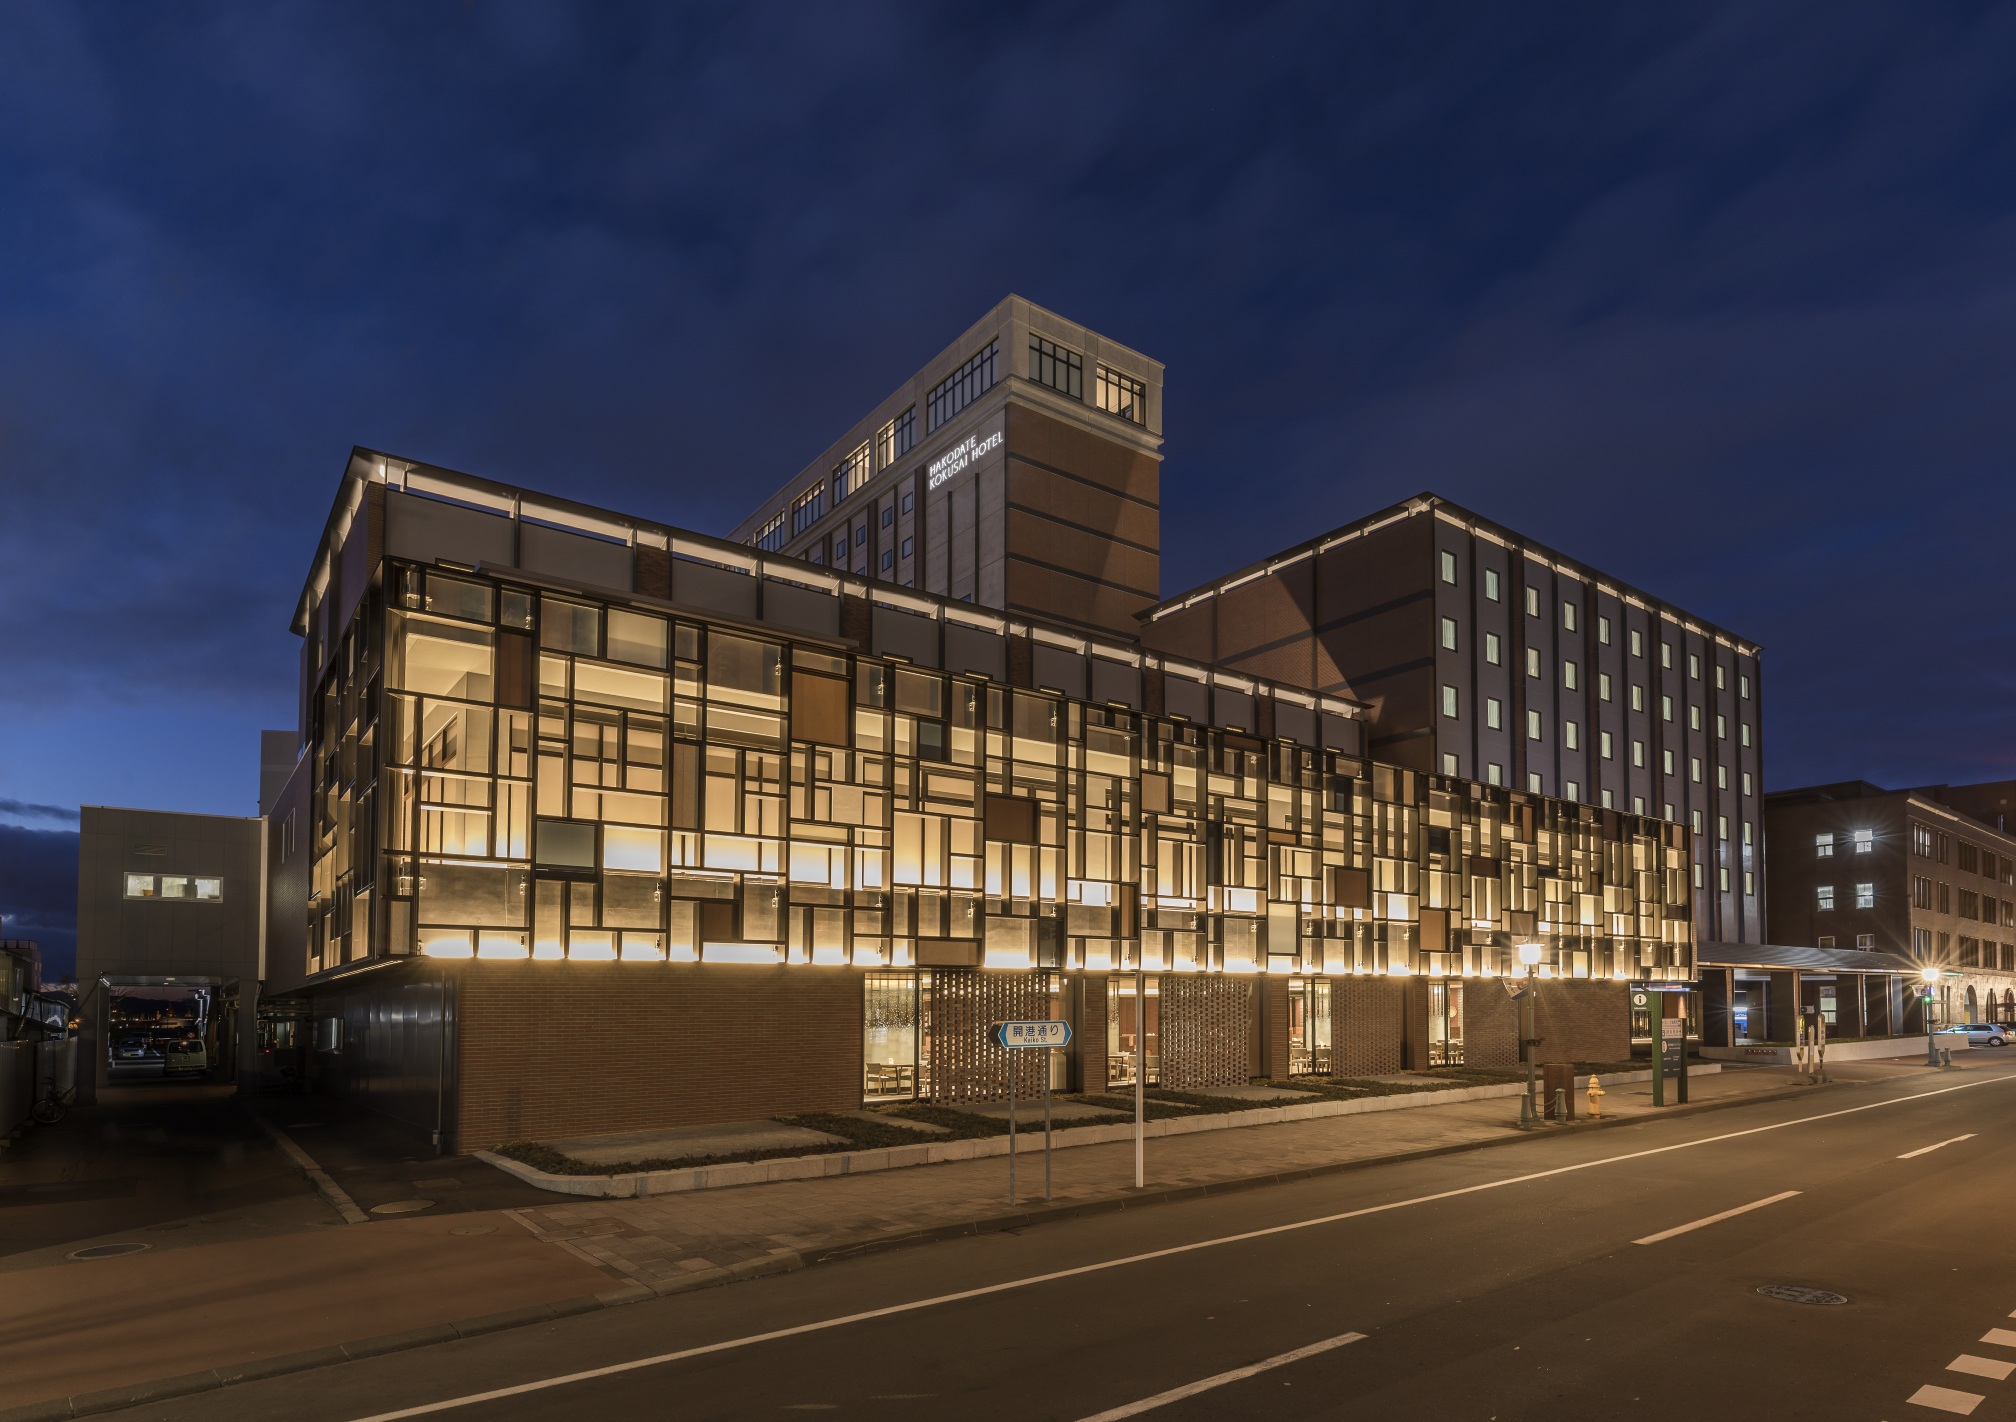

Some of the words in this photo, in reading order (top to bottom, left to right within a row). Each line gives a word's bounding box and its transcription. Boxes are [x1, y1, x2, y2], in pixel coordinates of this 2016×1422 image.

[929, 434, 977, 477] HAKODATE
[929, 454, 968, 491] KOKUSAI
[971, 431, 1004, 462] HOTEL
[1013, 1024, 1059, 1037] 開港通り
